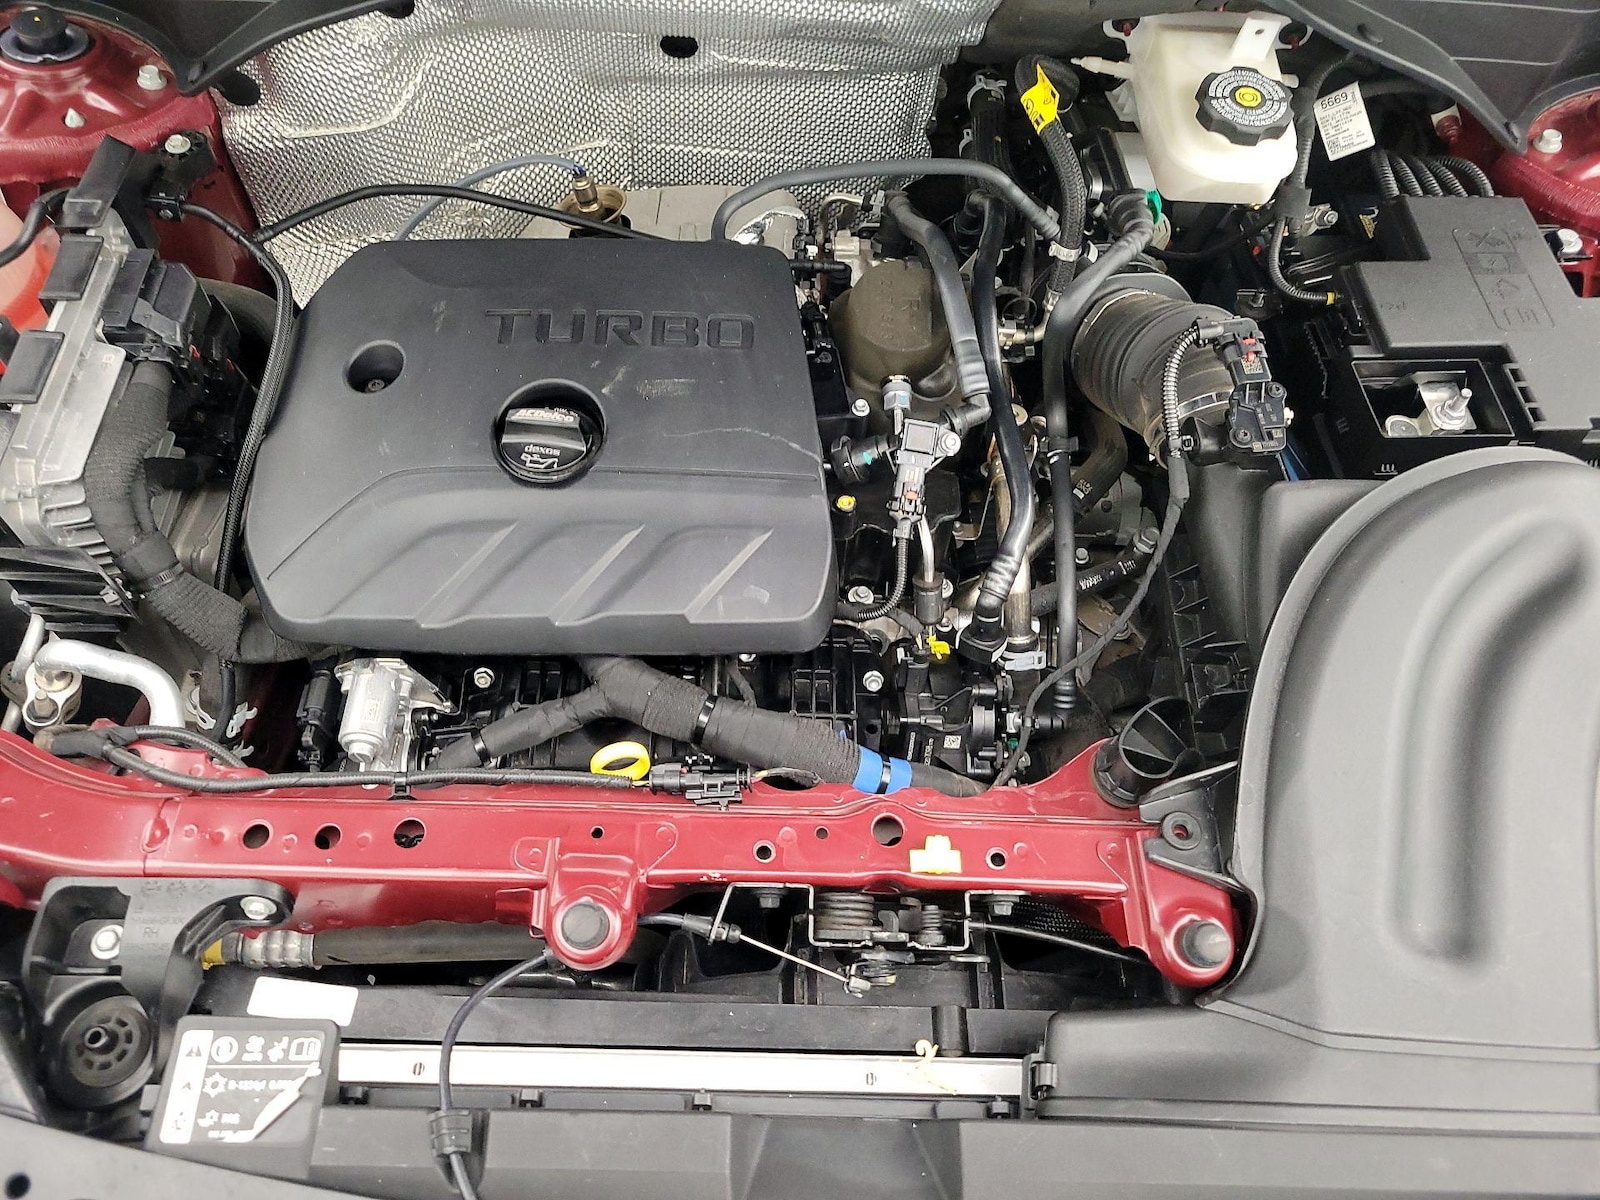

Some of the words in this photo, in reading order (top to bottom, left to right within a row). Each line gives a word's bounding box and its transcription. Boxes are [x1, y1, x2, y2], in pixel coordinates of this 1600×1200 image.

[1320, 91, 1348, 109] 6669
[485, 309, 755, 349] TURBO
[515, 409, 574, 422] ACDelco
[525, 444, 560, 456] dexos
